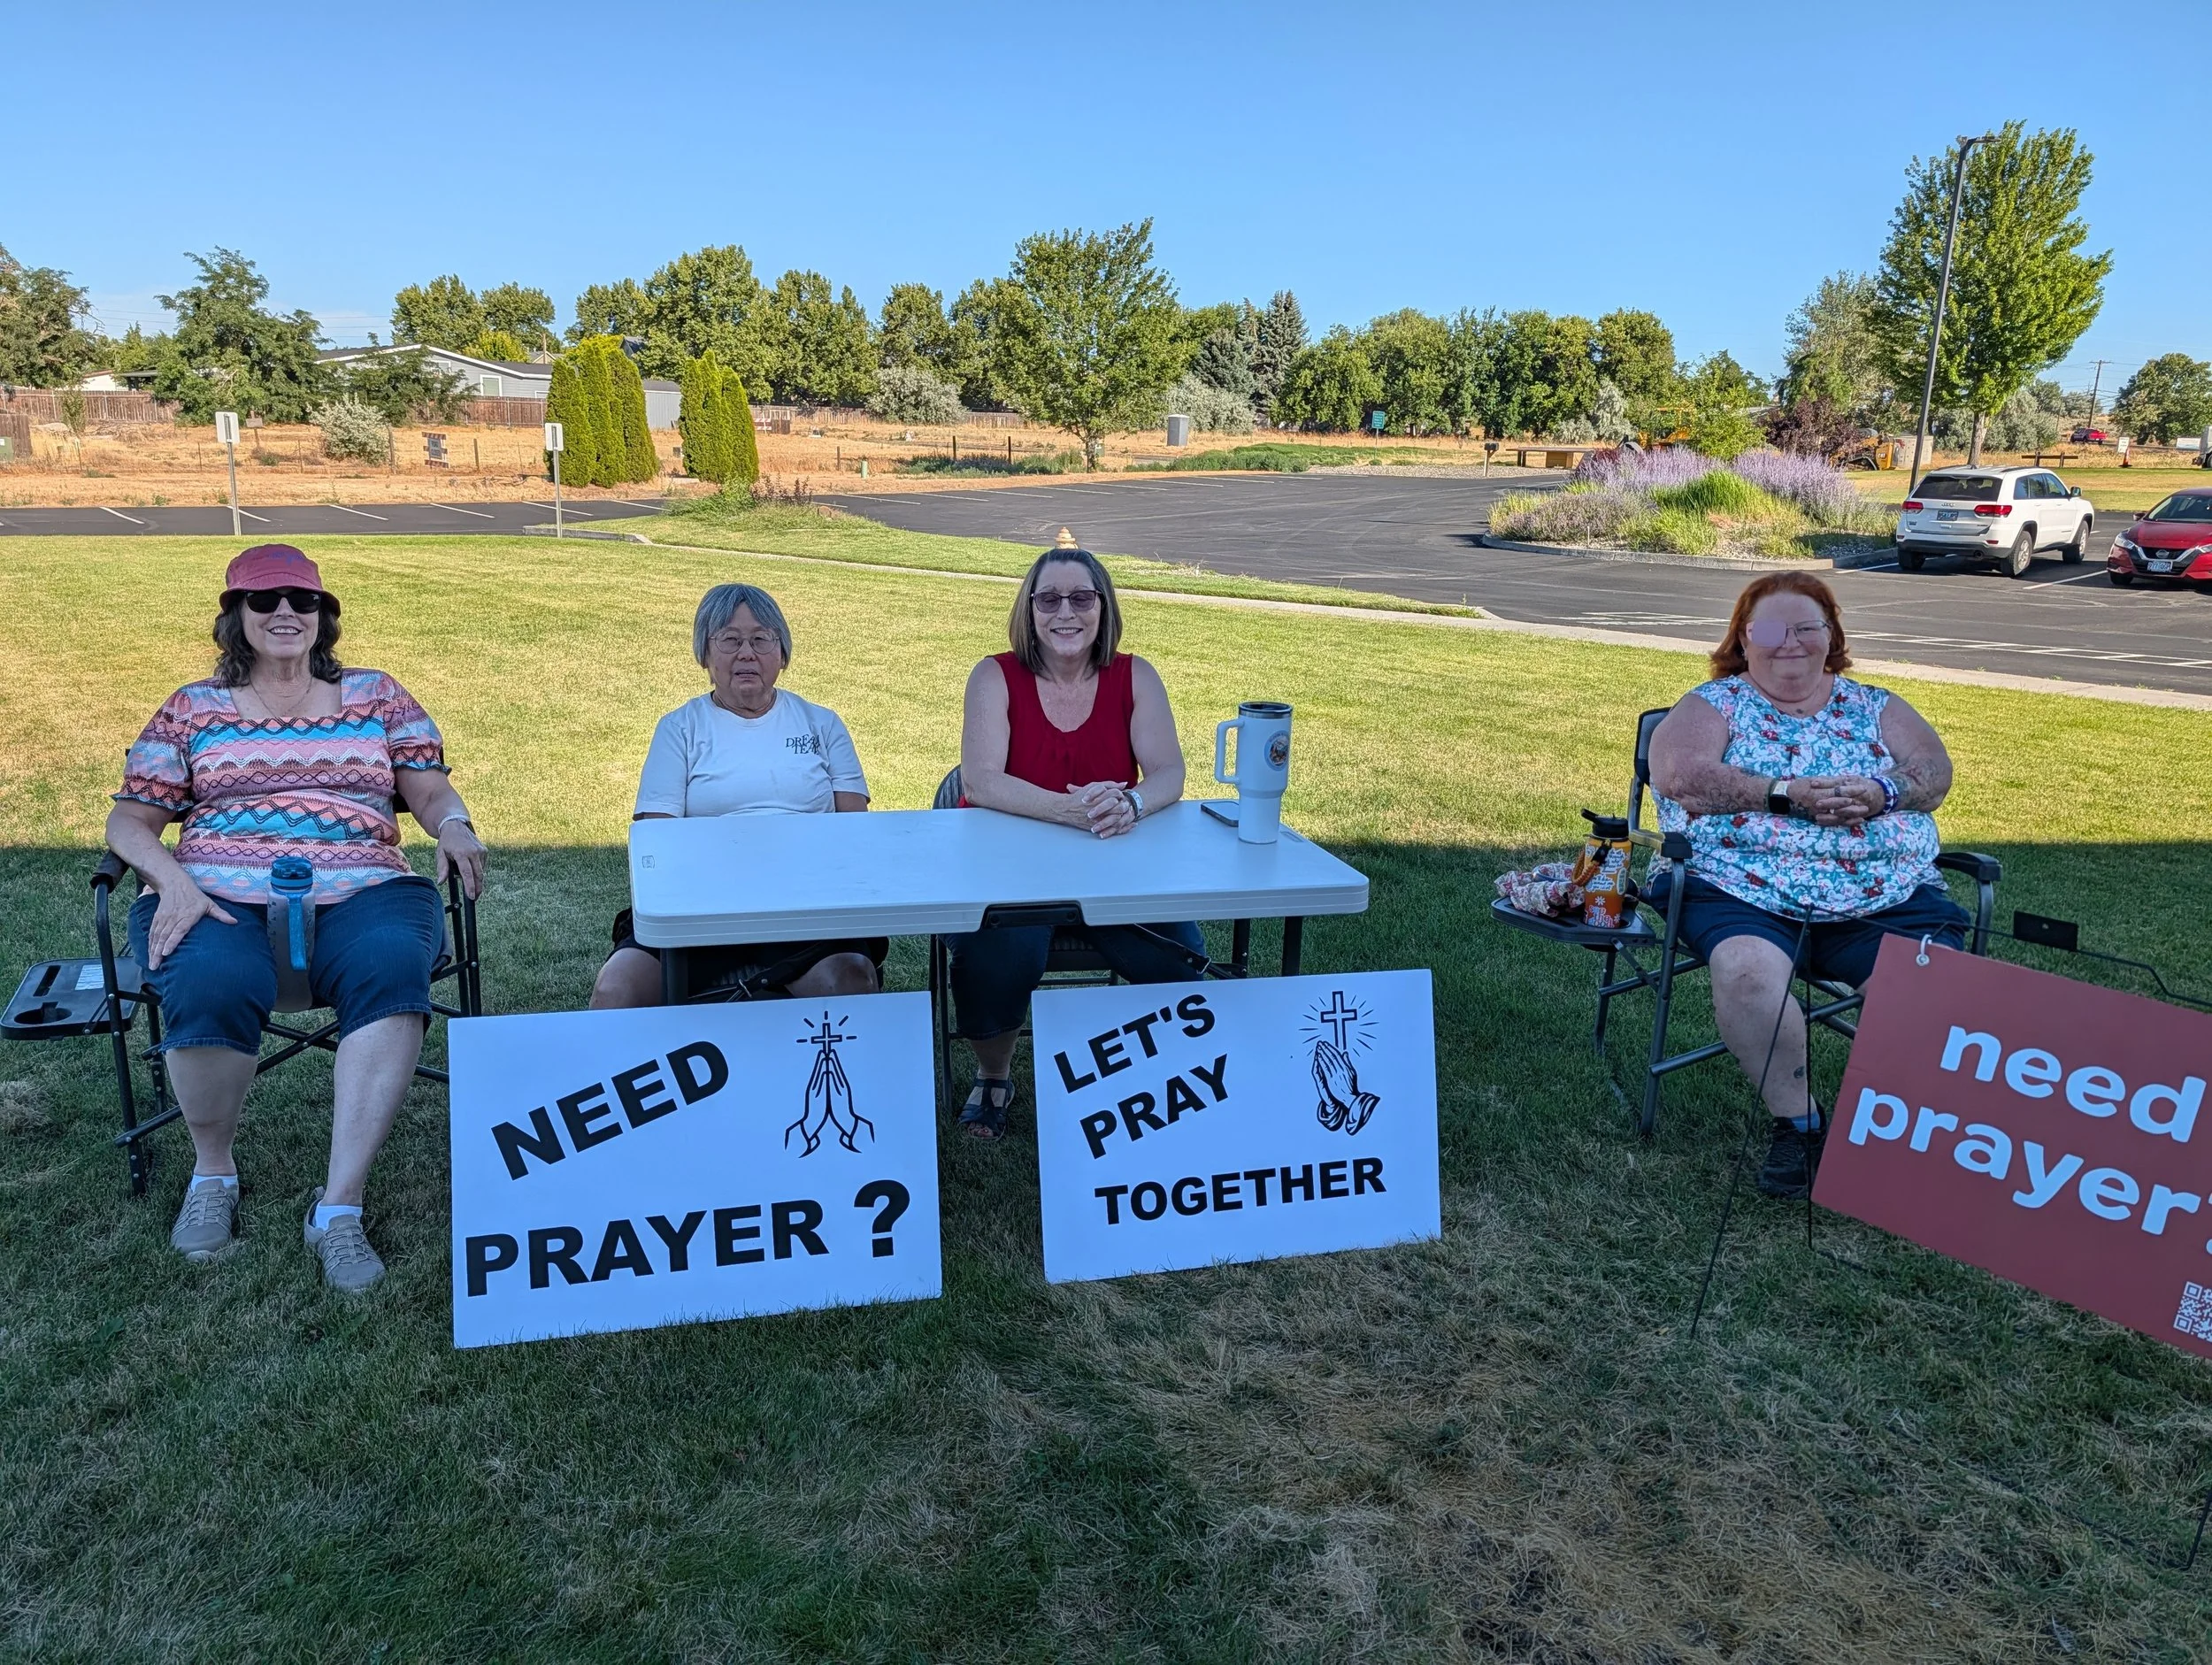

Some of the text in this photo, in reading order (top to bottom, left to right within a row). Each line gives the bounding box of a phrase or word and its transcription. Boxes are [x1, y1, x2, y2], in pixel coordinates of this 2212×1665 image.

[1053, 994, 1216, 1094] LET'S
[1939, 1024, 2208, 1143] need
[490, 1040, 729, 1181] NEED
[1079, 1053, 1229, 1160] PRAY
[1094, 1157, 1387, 1225] TOGETHER
[1847, 1087, 2212, 1255] prayer
[465, 1179, 910, 1298] PRAYER ?
